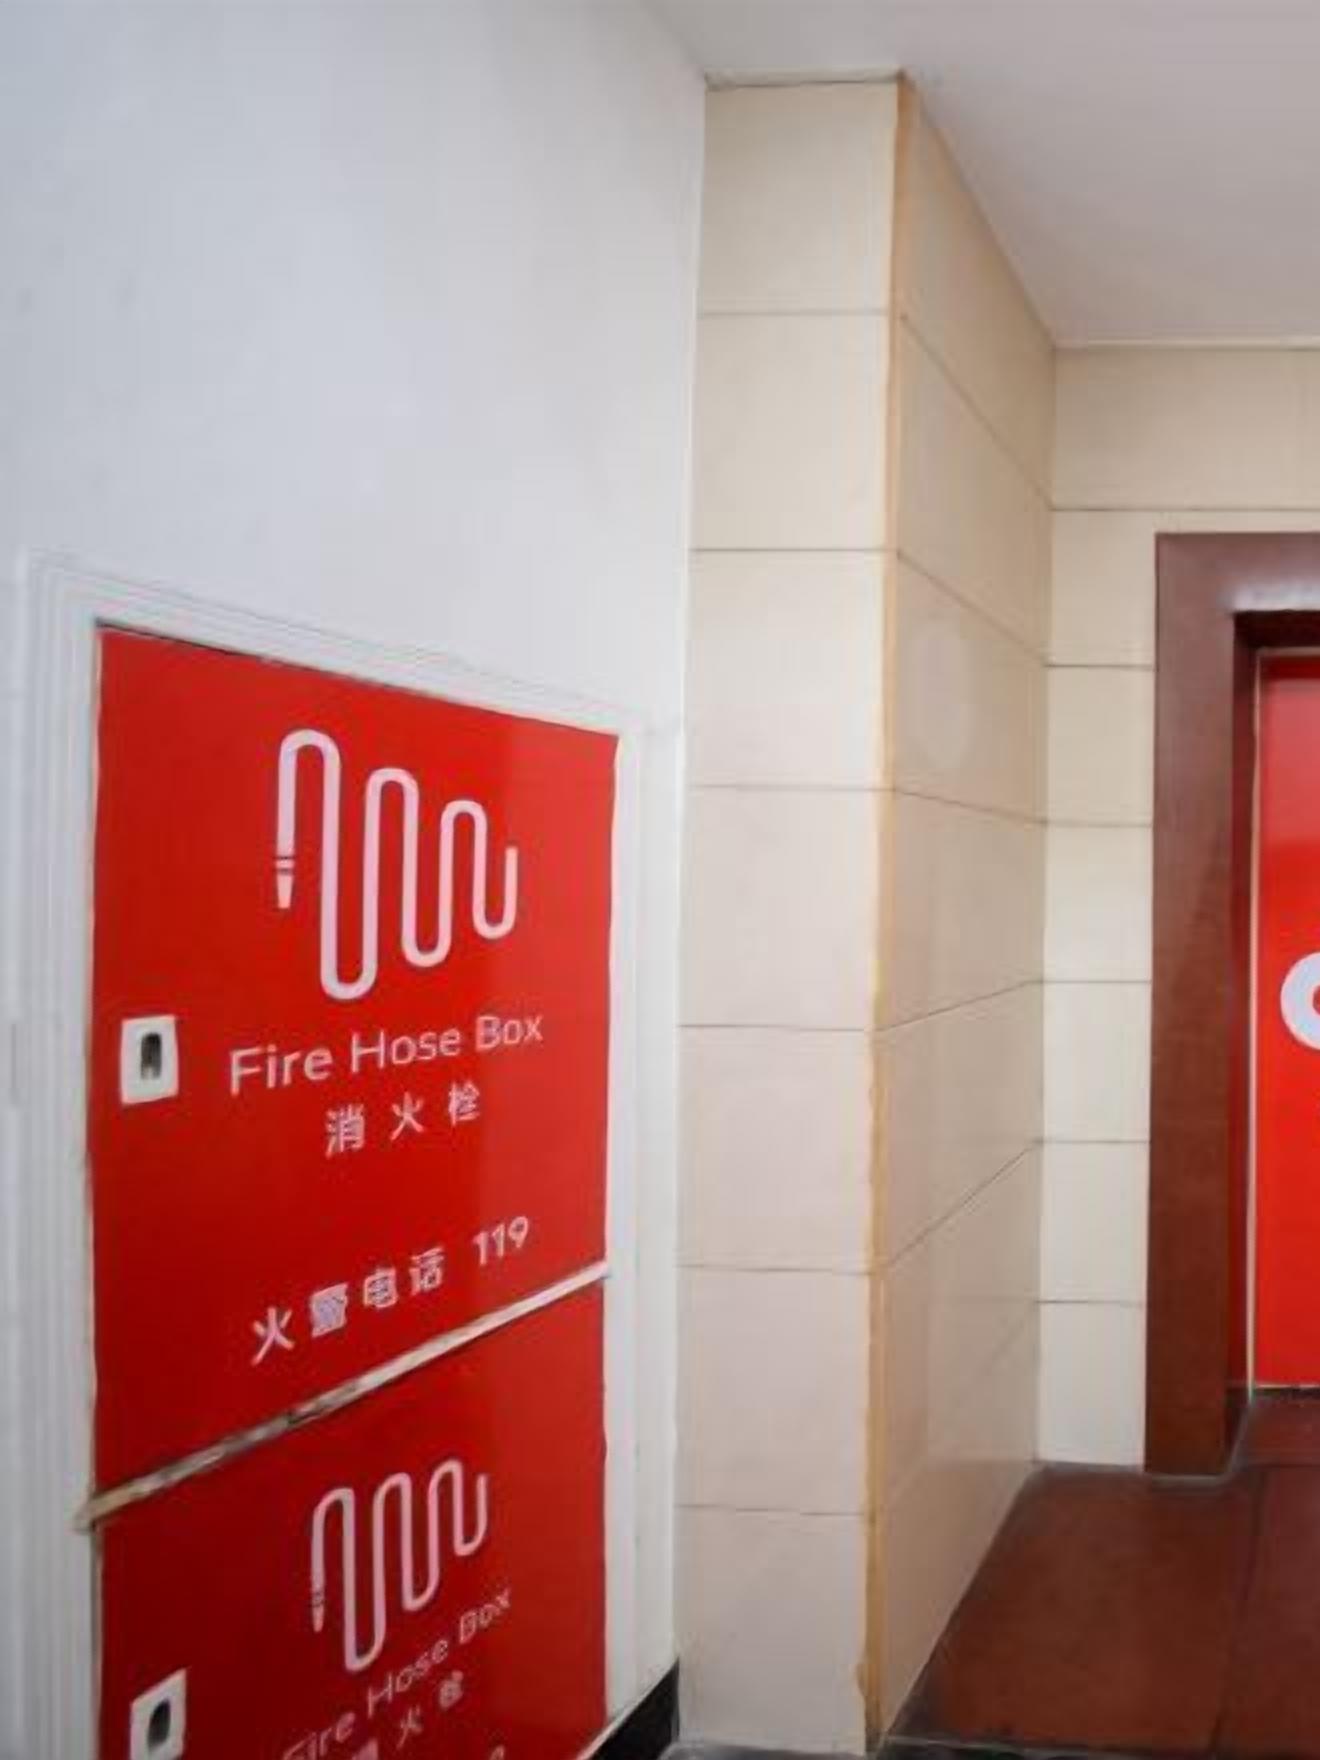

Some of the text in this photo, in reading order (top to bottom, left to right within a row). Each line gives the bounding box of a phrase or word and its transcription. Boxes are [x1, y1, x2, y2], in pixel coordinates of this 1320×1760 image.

[229, 1014, 544, 1096] Fire Hose Box
[324, 1080, 481, 1160] 消火栓
[472, 1215, 530, 1266] 119
[366, 1638, 450, 1721] Hose
[458, 1587, 512, 1646] Box
